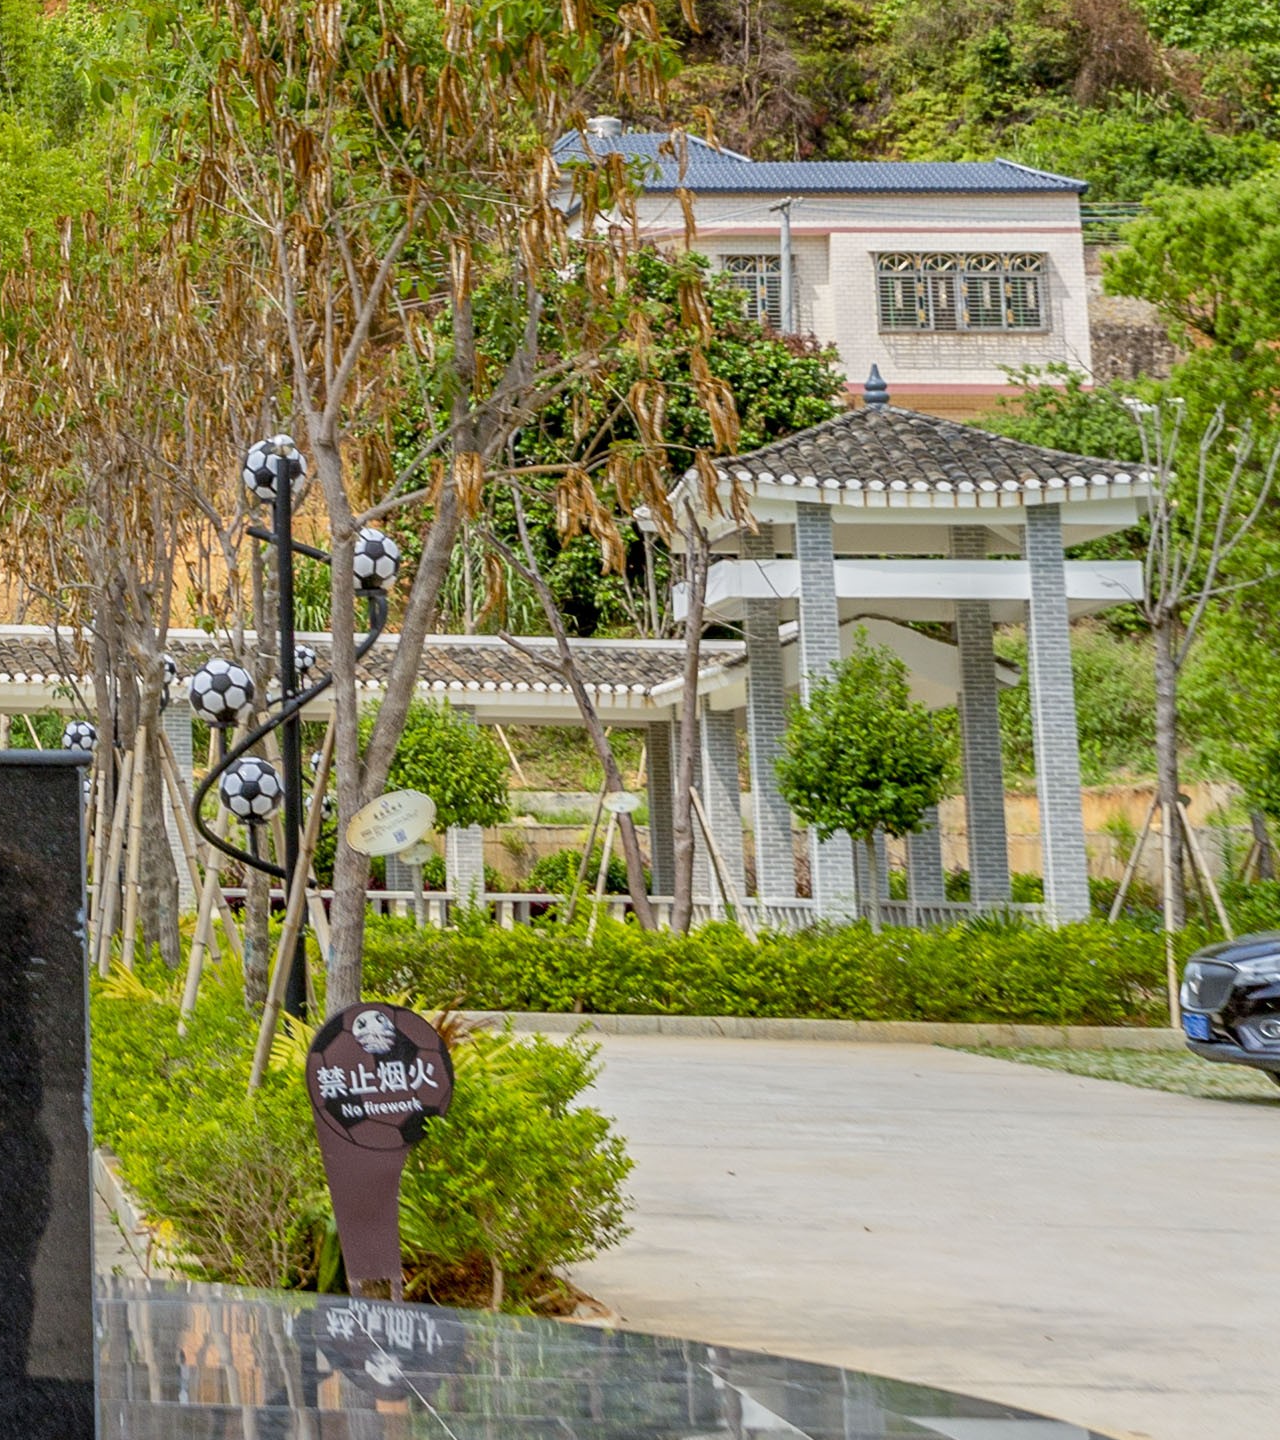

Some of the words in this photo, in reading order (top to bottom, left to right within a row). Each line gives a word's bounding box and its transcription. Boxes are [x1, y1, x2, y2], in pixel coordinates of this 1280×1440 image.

[319, 1058, 439, 1099] 禁止烟火
[341, 1103, 363, 1118] No
[364, 1097, 424, 1116] firework
